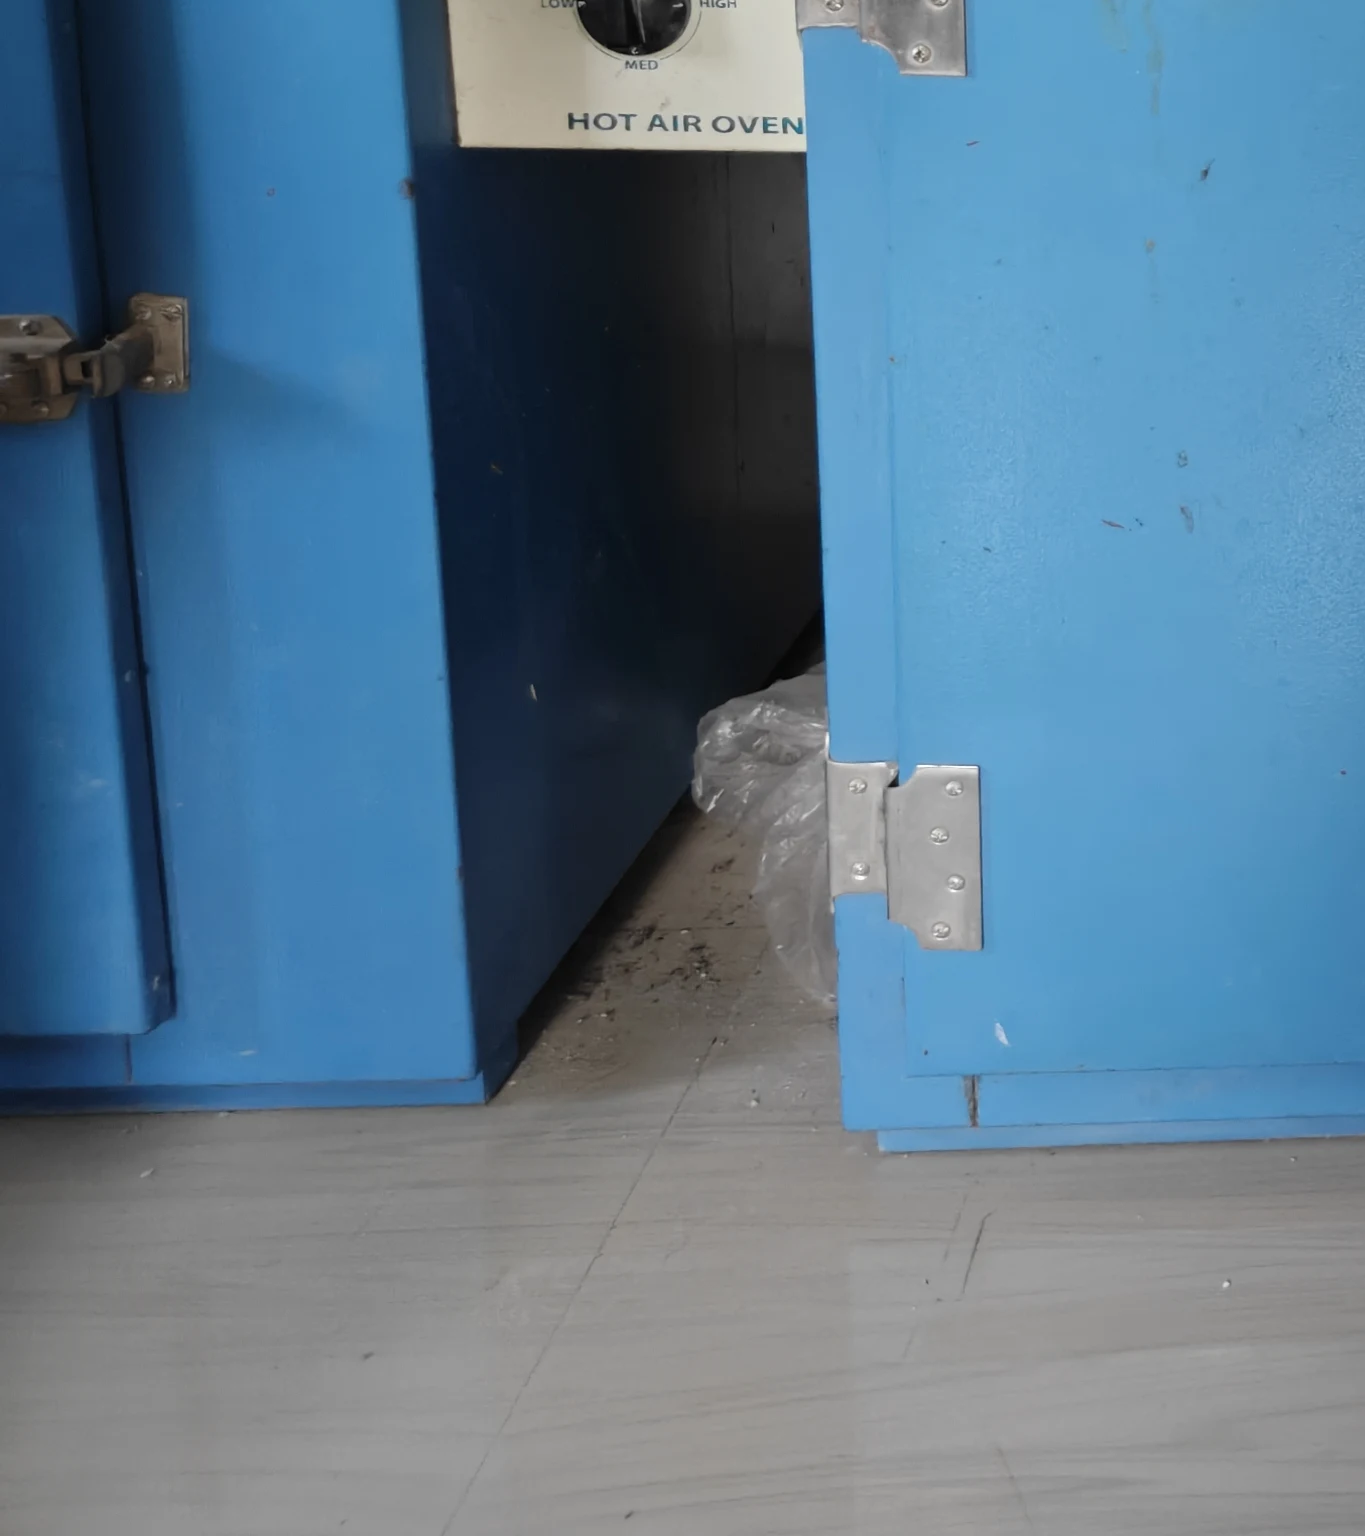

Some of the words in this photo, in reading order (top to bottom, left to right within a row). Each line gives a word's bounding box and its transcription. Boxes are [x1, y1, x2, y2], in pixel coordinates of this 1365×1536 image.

[624, 59, 659, 71] MED
[566, 111, 638, 133] HOT
[646, 112, 703, 134] AIR
[709, 113, 804, 136] OVEN
